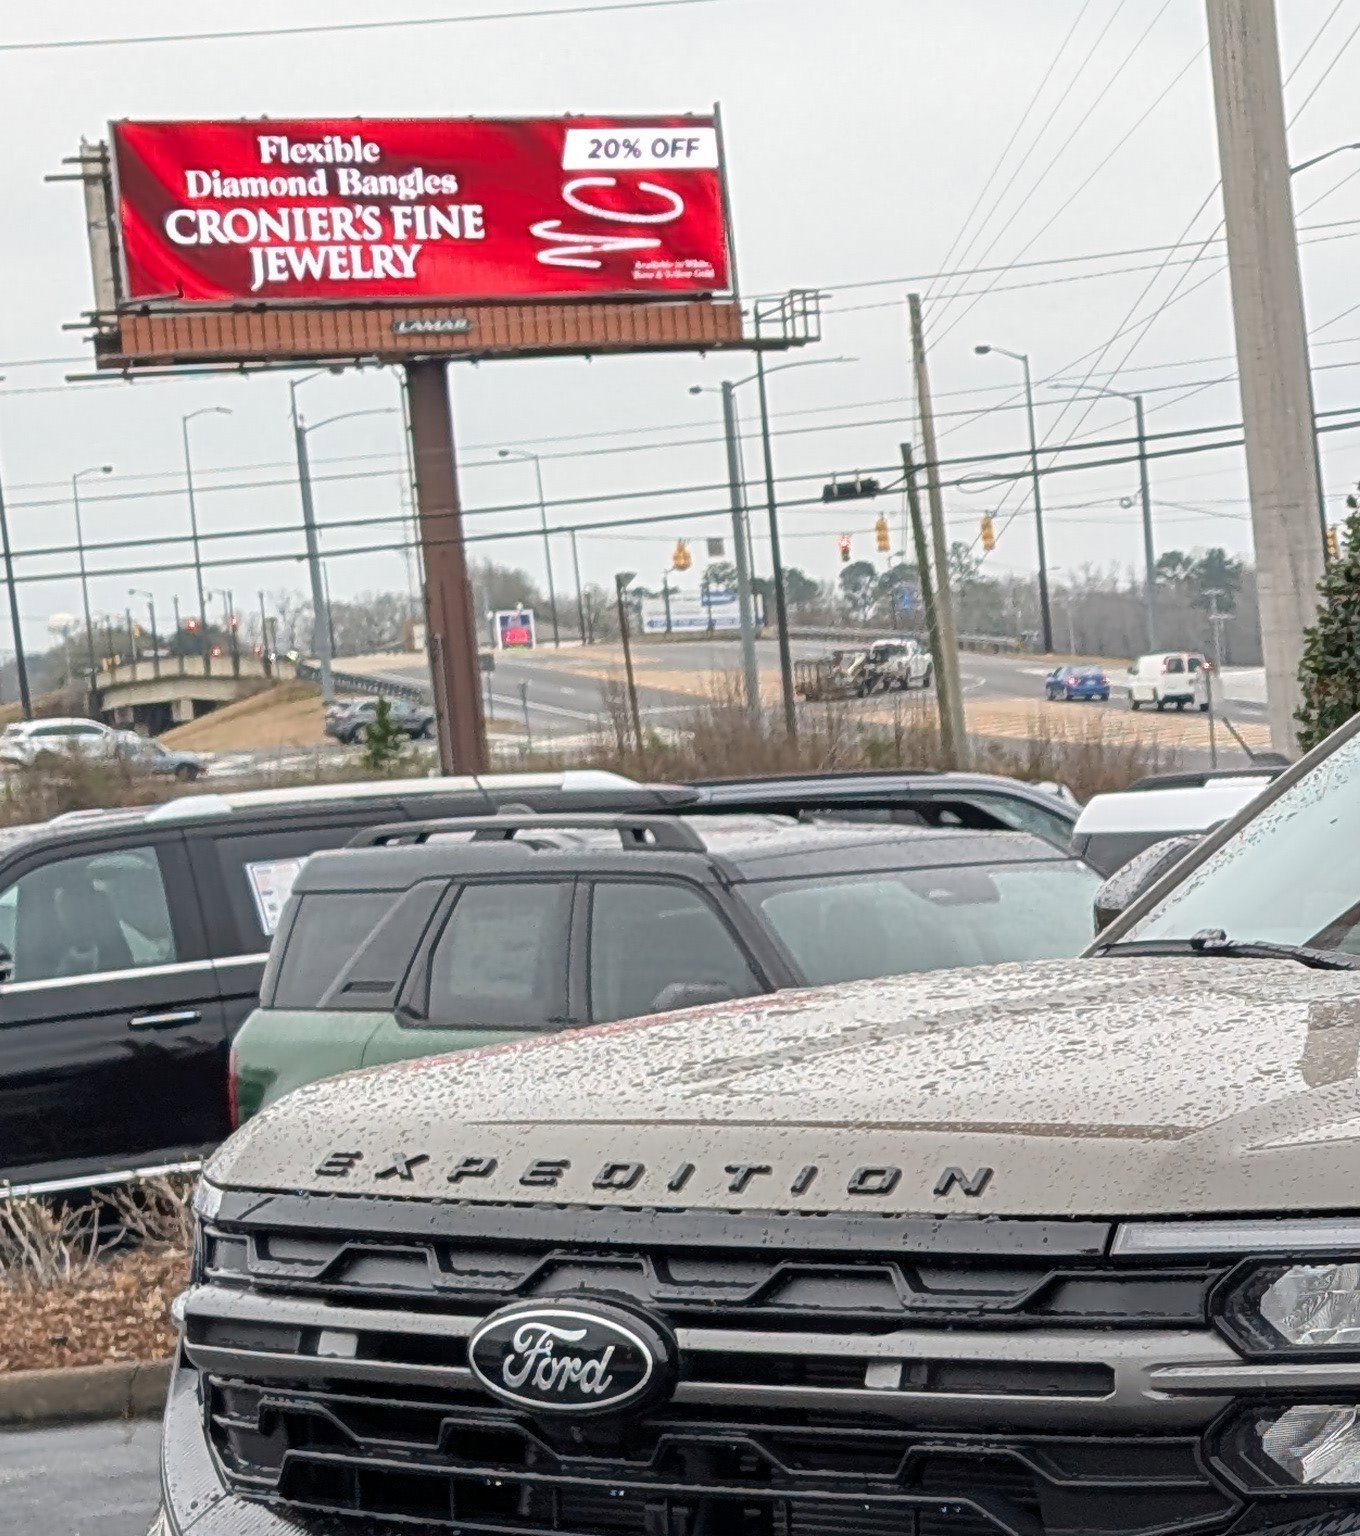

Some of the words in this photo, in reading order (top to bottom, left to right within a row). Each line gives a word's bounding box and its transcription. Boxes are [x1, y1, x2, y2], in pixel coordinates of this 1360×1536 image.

[257, 135, 380, 164] Flexible
[588, 138, 642, 159] 20%
[651, 138, 701, 159] OFF
[184, 168, 328, 199] Diamond
[338, 167, 459, 201] Bangles
[165, 205, 383, 245] CRONIER'S
[390, 204, 486, 240] FINE
[250, 243, 422, 292] JEWELRY
[314, 1150, 997, 1198] EXPEDITION
[503, 1322, 614, 1395] Ford
